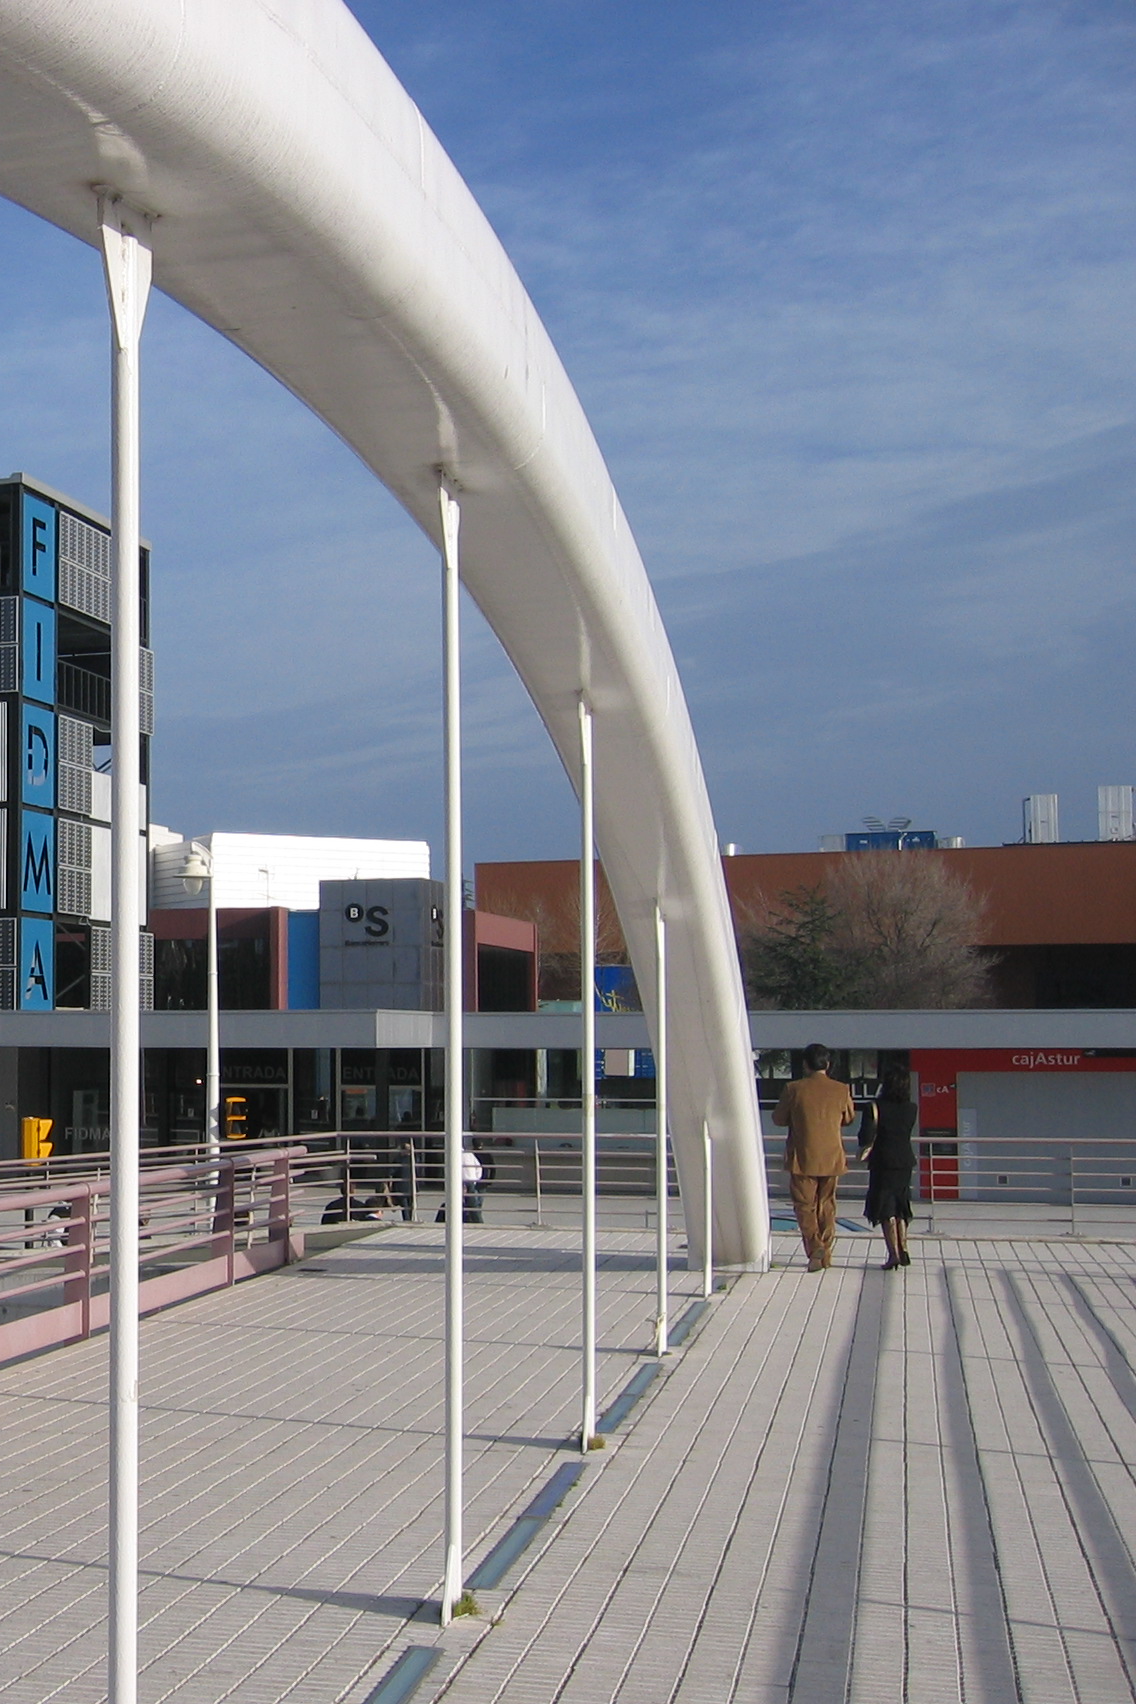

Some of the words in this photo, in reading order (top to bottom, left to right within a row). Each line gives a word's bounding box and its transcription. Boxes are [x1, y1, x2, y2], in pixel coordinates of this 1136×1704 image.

[1012, 1052, 1081, 1069] cajAstur
[222, 1065, 287, 1079] NTRADA
[343, 1066, 420, 1080] ENTADA
[65, 1127, 111, 1140] FIDMA
